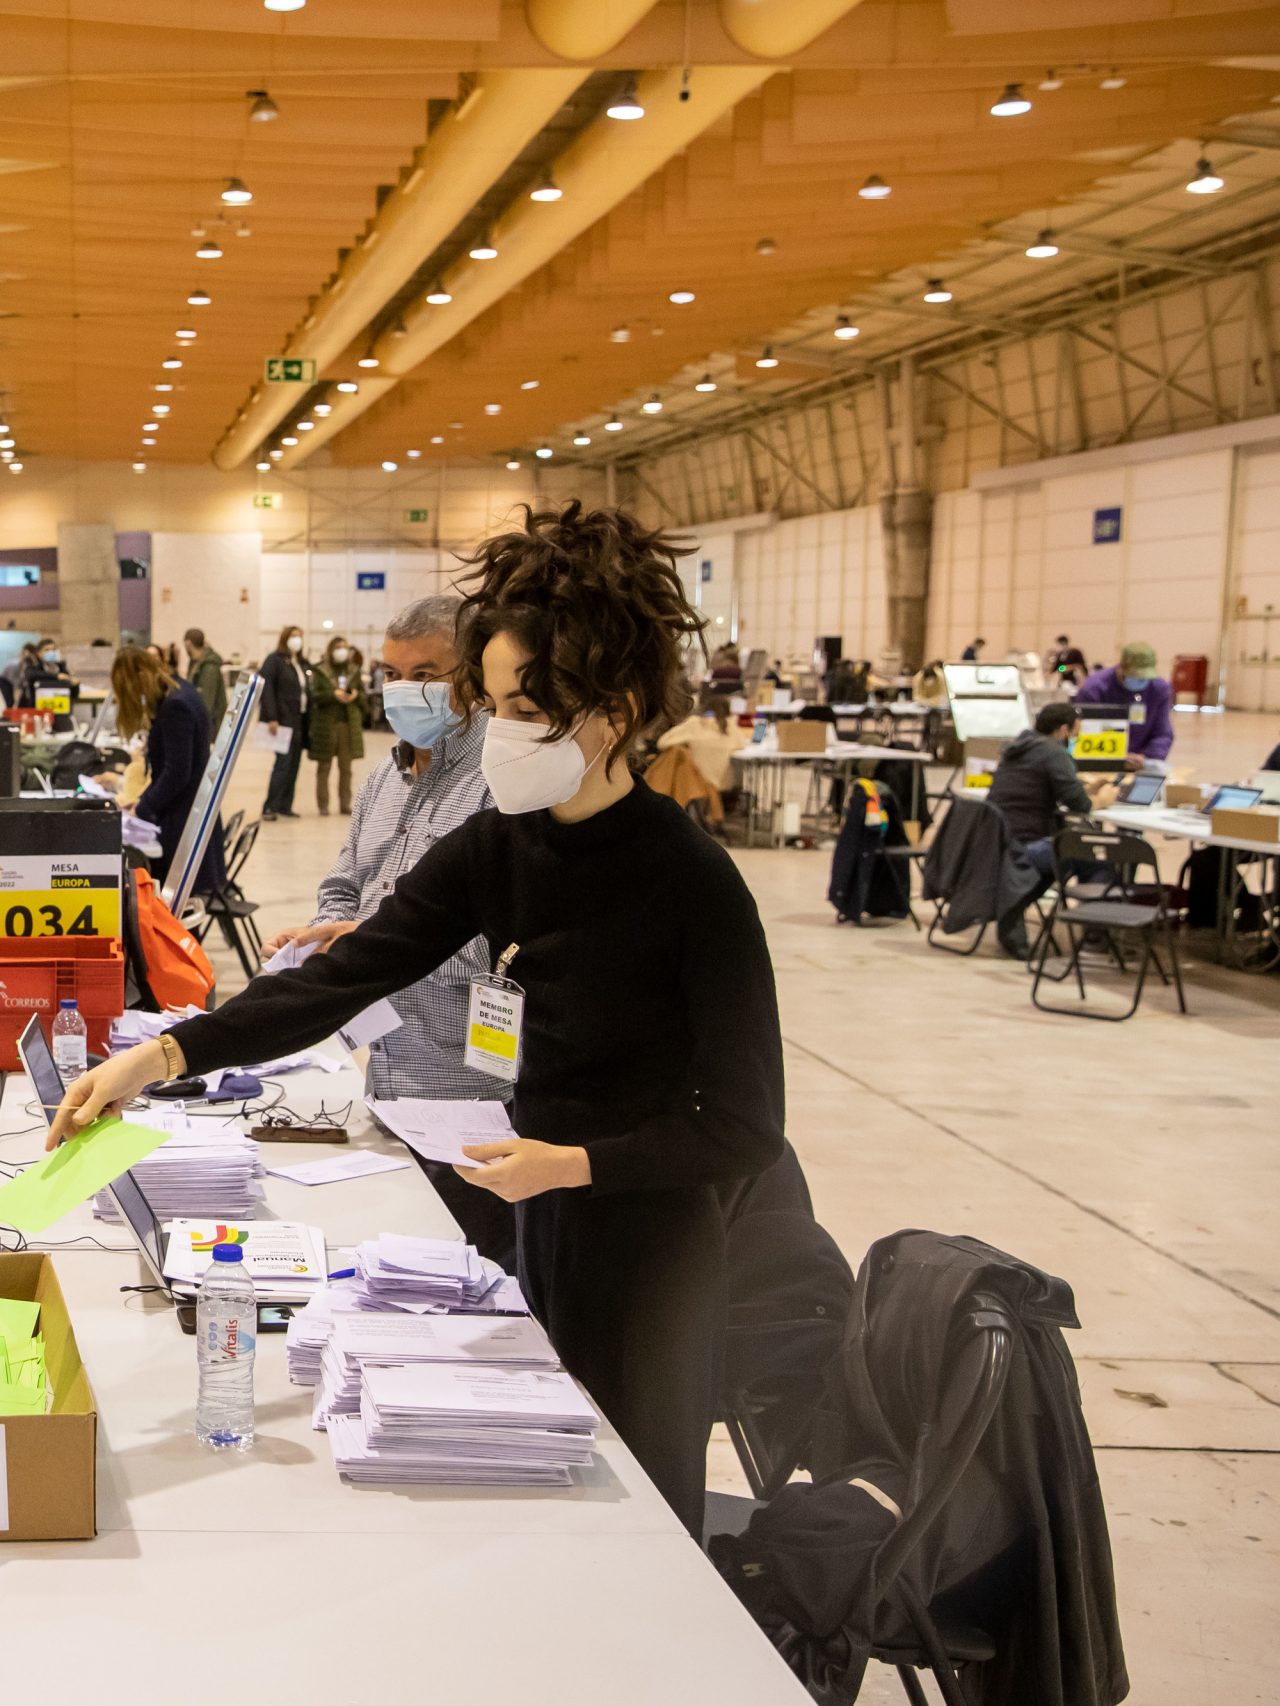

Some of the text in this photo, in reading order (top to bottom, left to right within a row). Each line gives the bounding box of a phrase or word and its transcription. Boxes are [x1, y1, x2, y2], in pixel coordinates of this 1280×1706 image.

[1081, 738, 1117, 754] 043
[51, 863, 79, 873] MESA
[51, 878, 91, 888] EUROPA
[4, 904, 99, 937] 034
[4, 997, 50, 1008] CORREIOS
[480, 999, 513, 1016] MEMBRO
[479, 1010, 513, 1027] DE MESA
[481, 1021, 506, 1033] EUROPA
